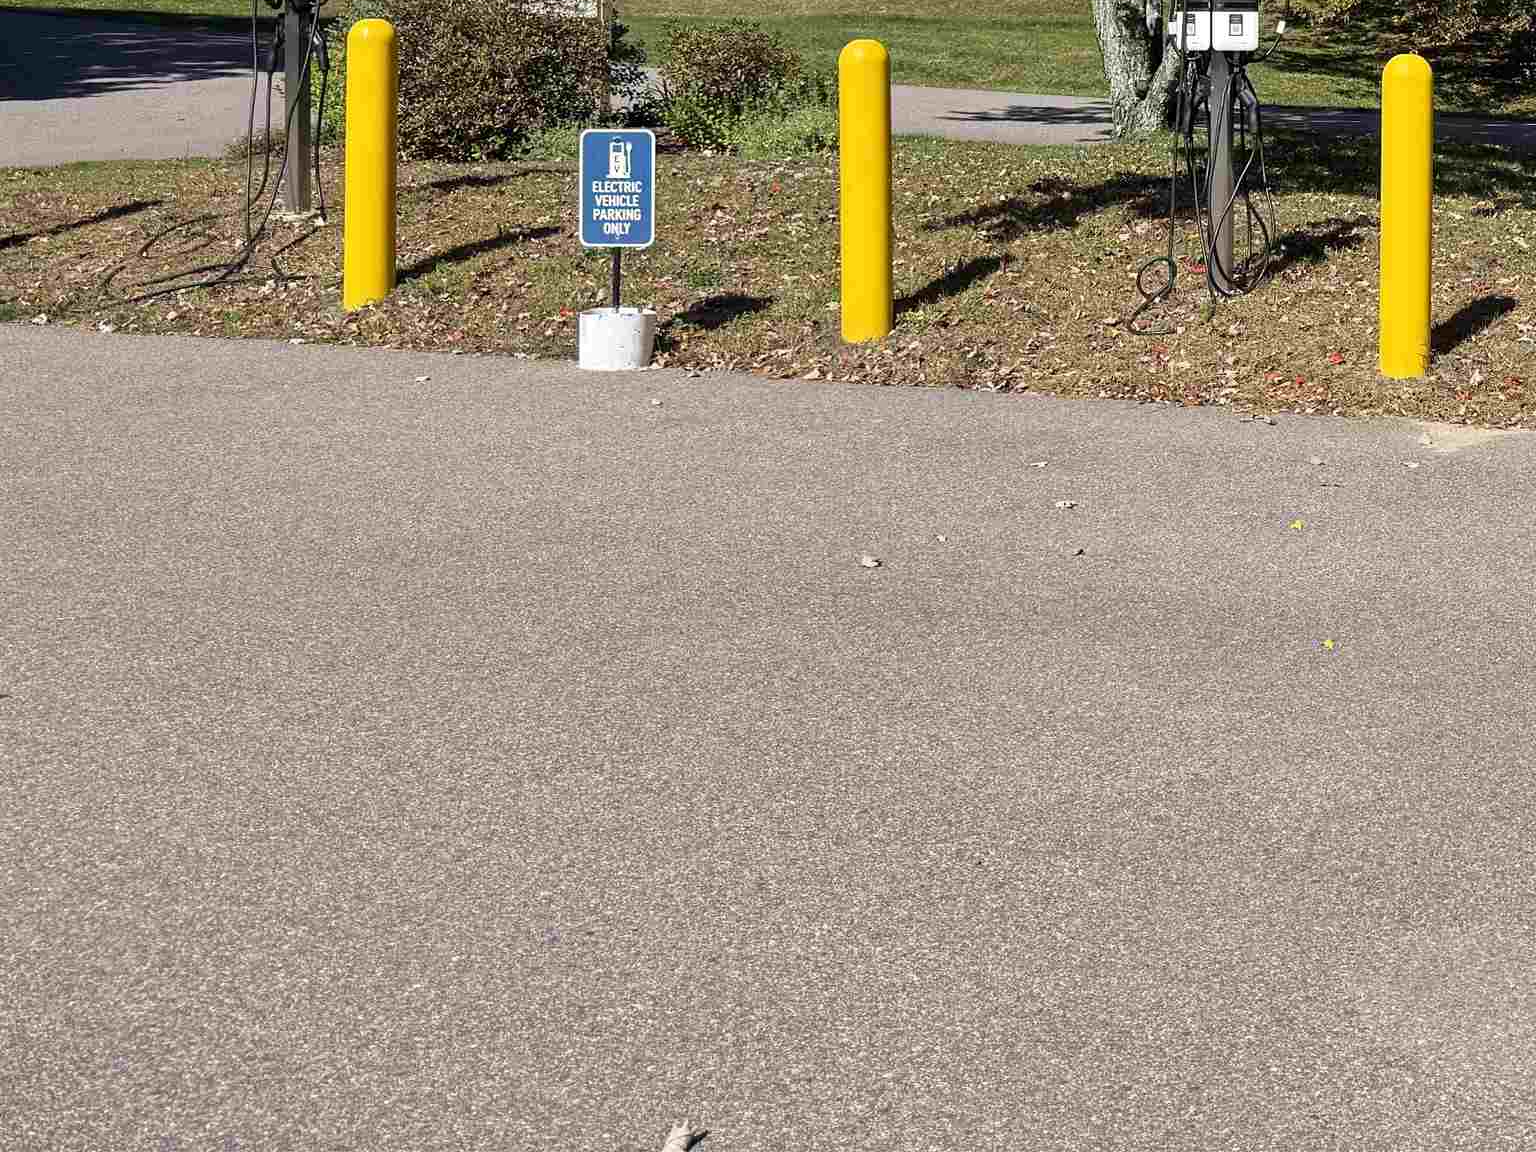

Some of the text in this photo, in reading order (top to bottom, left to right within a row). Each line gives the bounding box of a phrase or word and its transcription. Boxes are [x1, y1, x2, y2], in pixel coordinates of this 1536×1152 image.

[592, 181, 642, 193] ELECTRIC
[594, 194, 639, 207] VEHICLE
[592, 208, 641, 221] PARKING
[603, 222, 631, 234] ONLY
